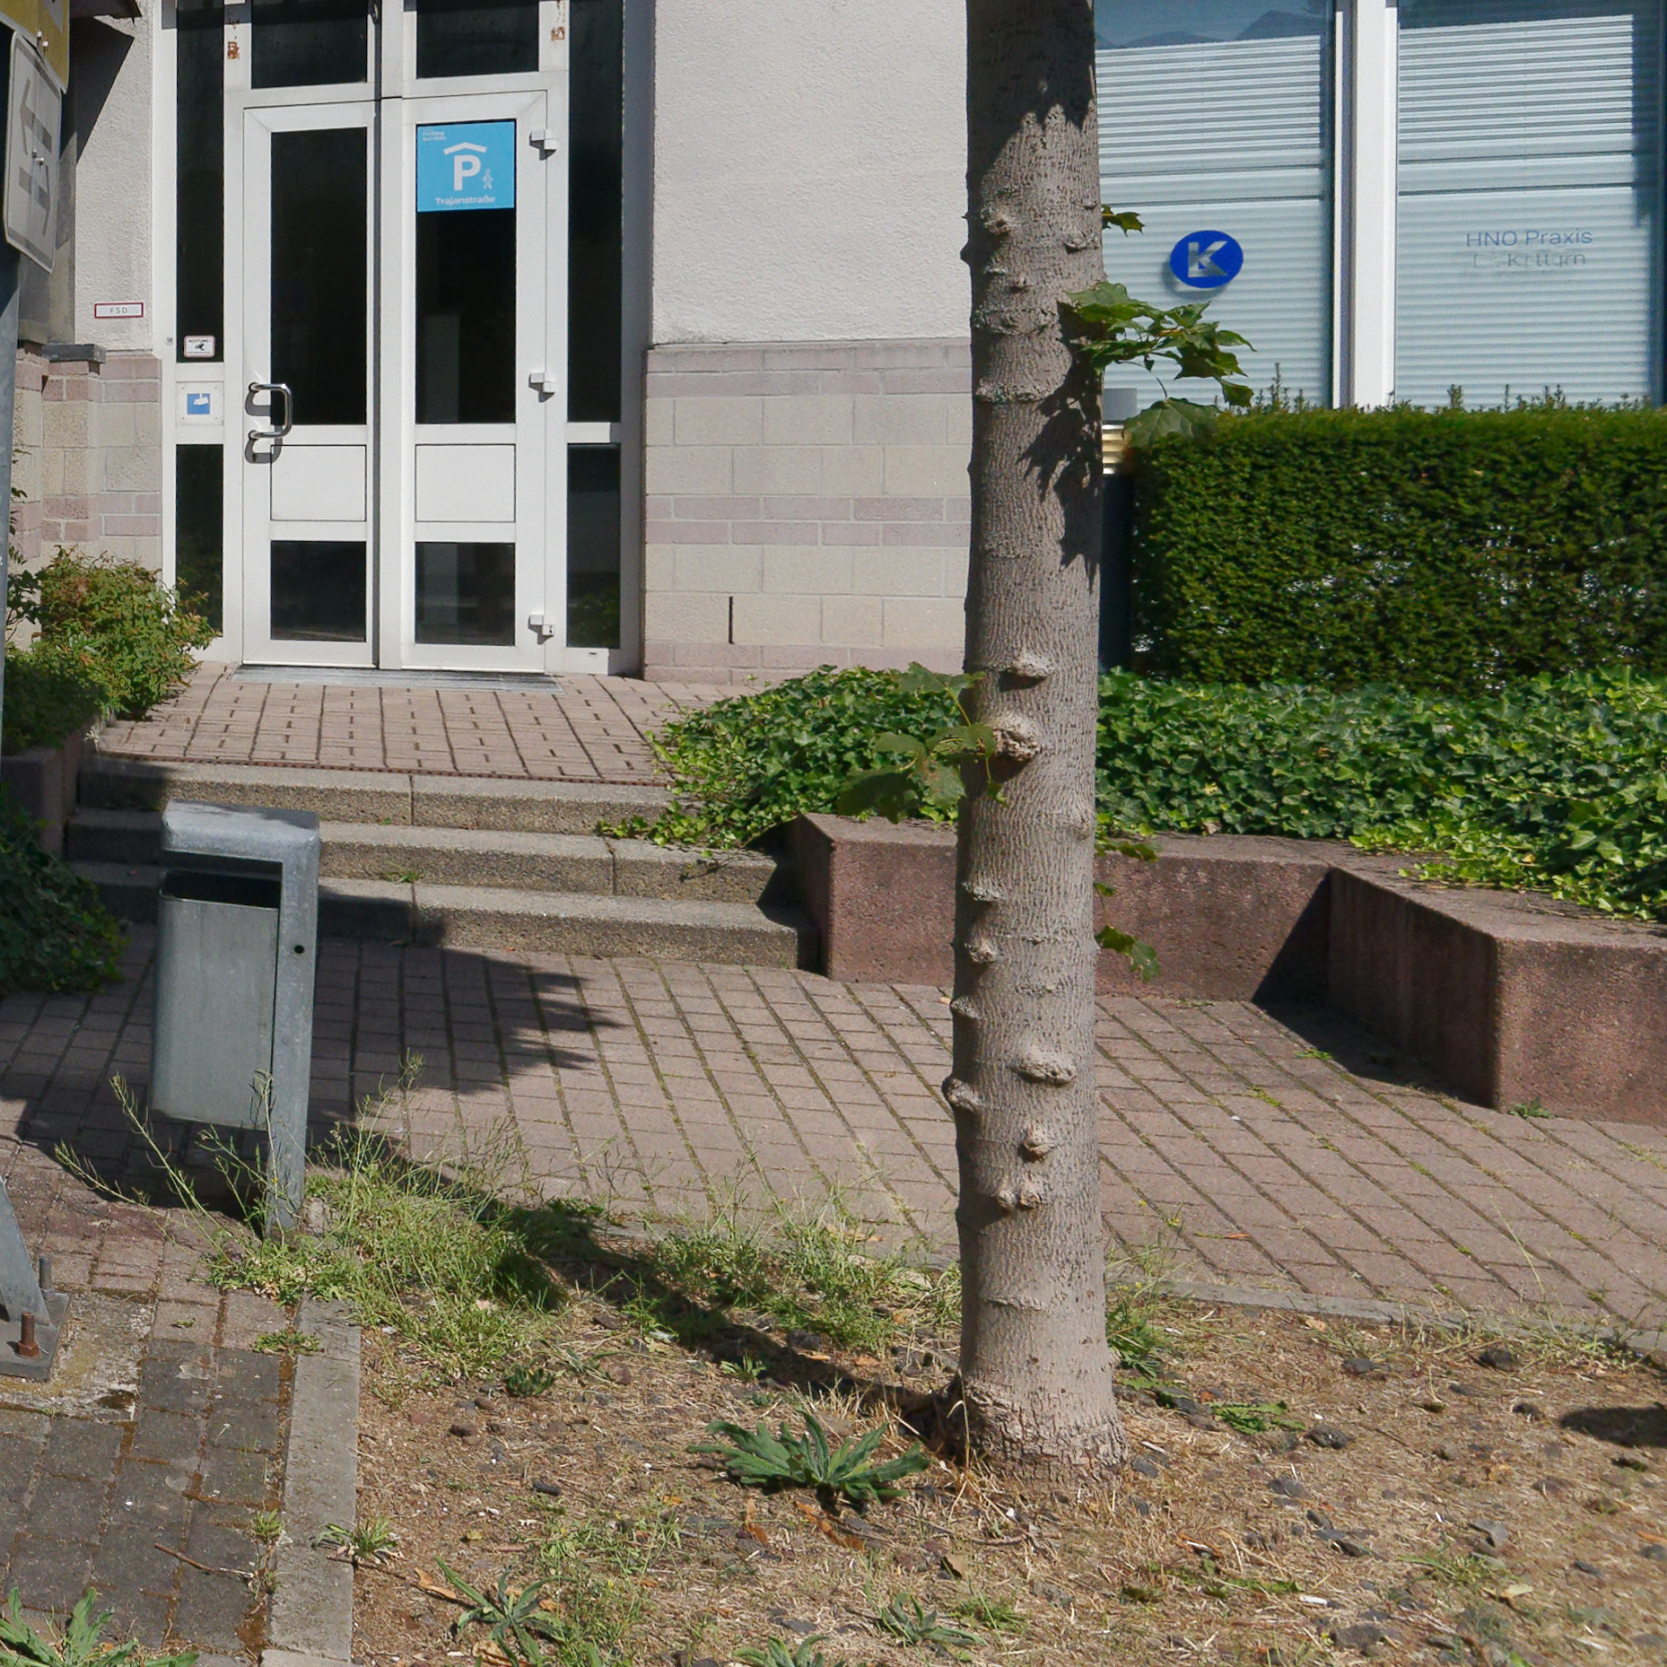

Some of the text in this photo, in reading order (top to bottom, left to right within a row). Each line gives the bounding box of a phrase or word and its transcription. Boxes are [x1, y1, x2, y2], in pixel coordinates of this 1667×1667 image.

[453, 154, 482, 191] P
[435, 195, 496, 206] Trajanstraße
[1466, 227, 1593, 246] HNO Praxis
